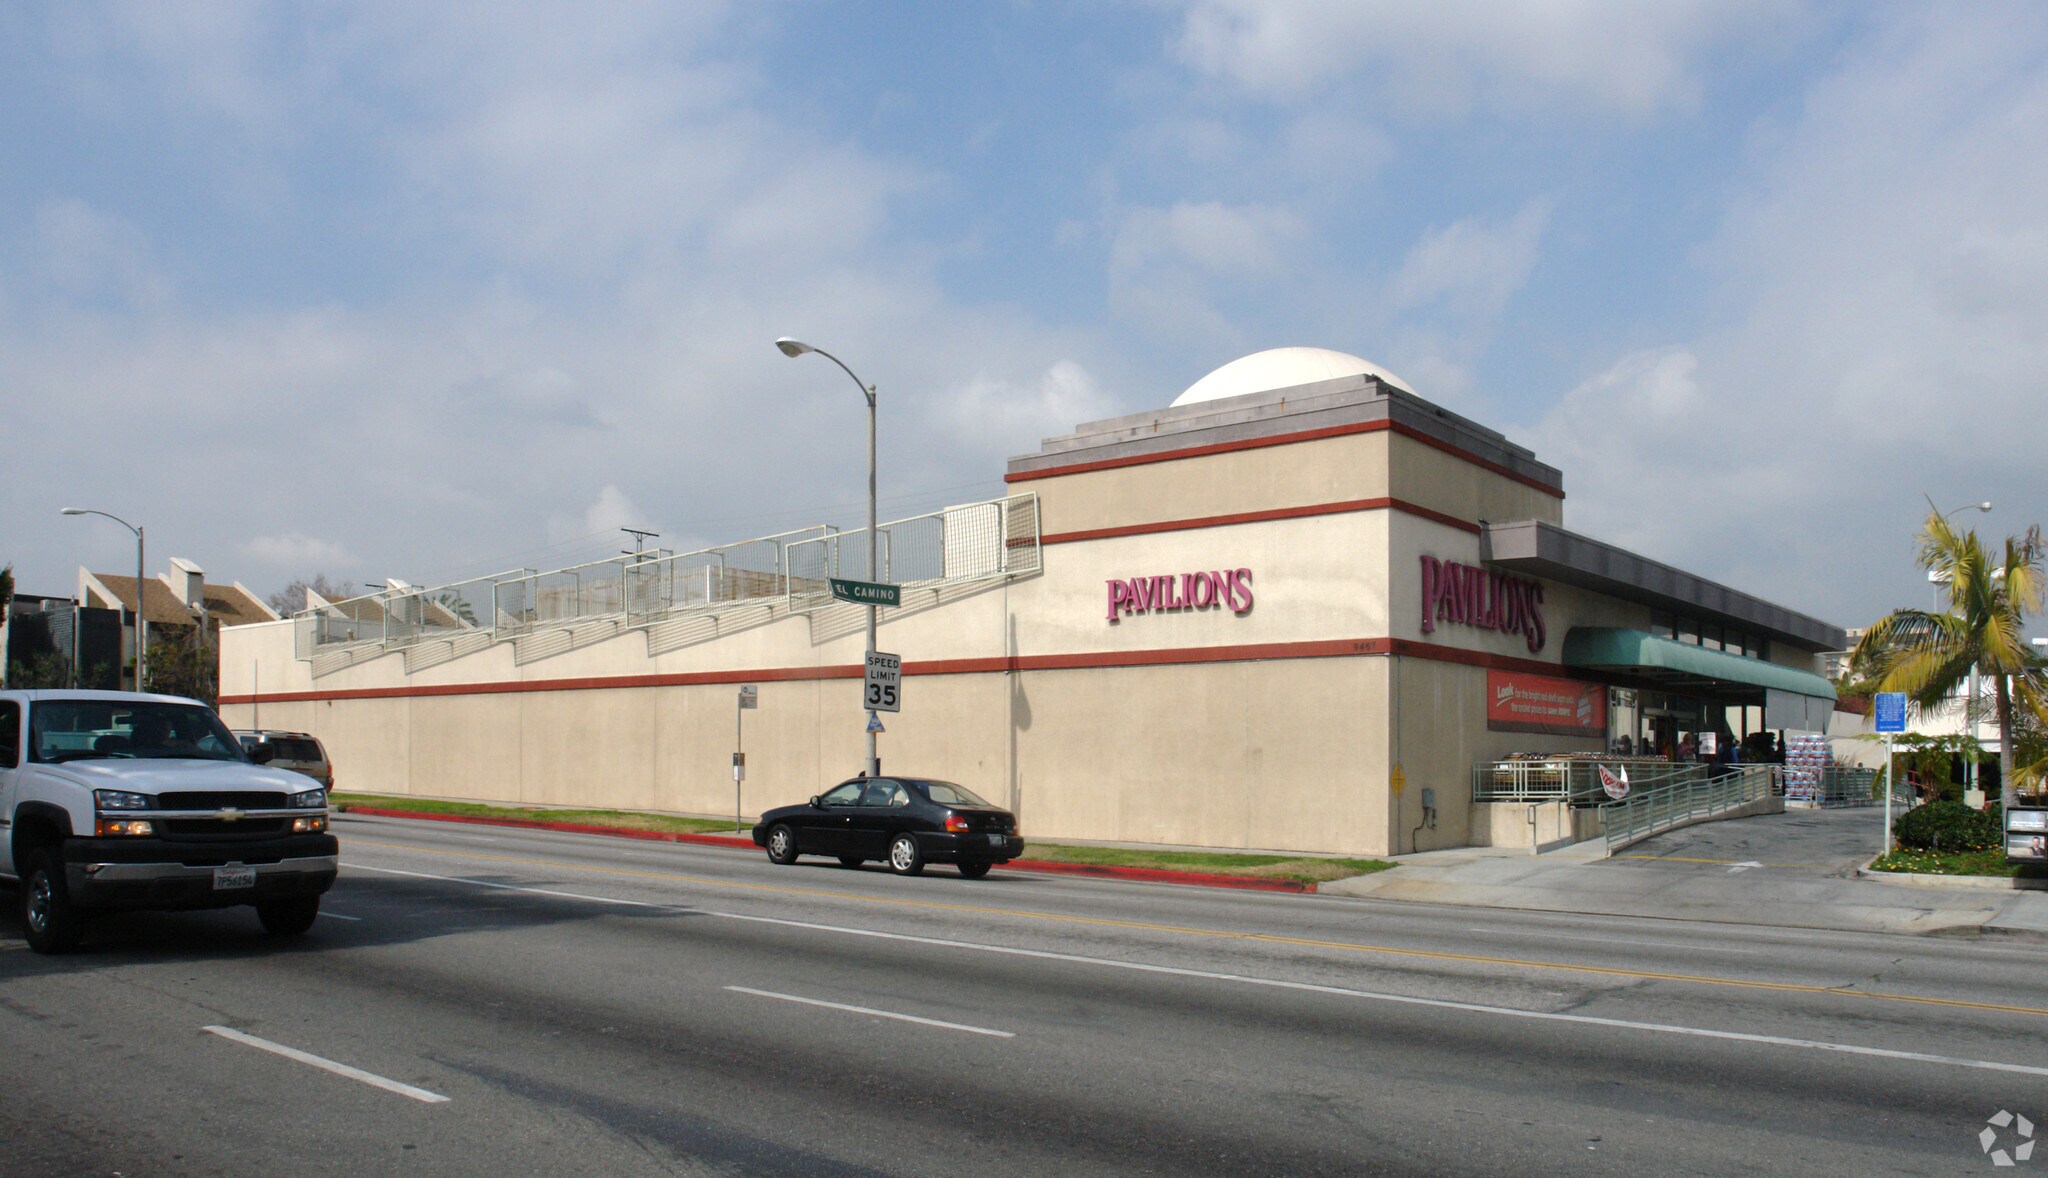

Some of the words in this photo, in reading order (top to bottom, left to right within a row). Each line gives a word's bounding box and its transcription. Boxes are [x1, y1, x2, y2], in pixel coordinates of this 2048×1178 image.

[835, 584, 848, 595] EL
[854, 586, 894, 600] CAMINO
[1105, 568, 1253, 620] PAVILIONS
[1420, 555, 1546, 653] PAVILIONS
[868, 656, 899, 669] SPEED
[870, 670, 896, 681] LIMIT
[868, 683, 896, 706] 35
[1497, 682, 1514, 698] Look
